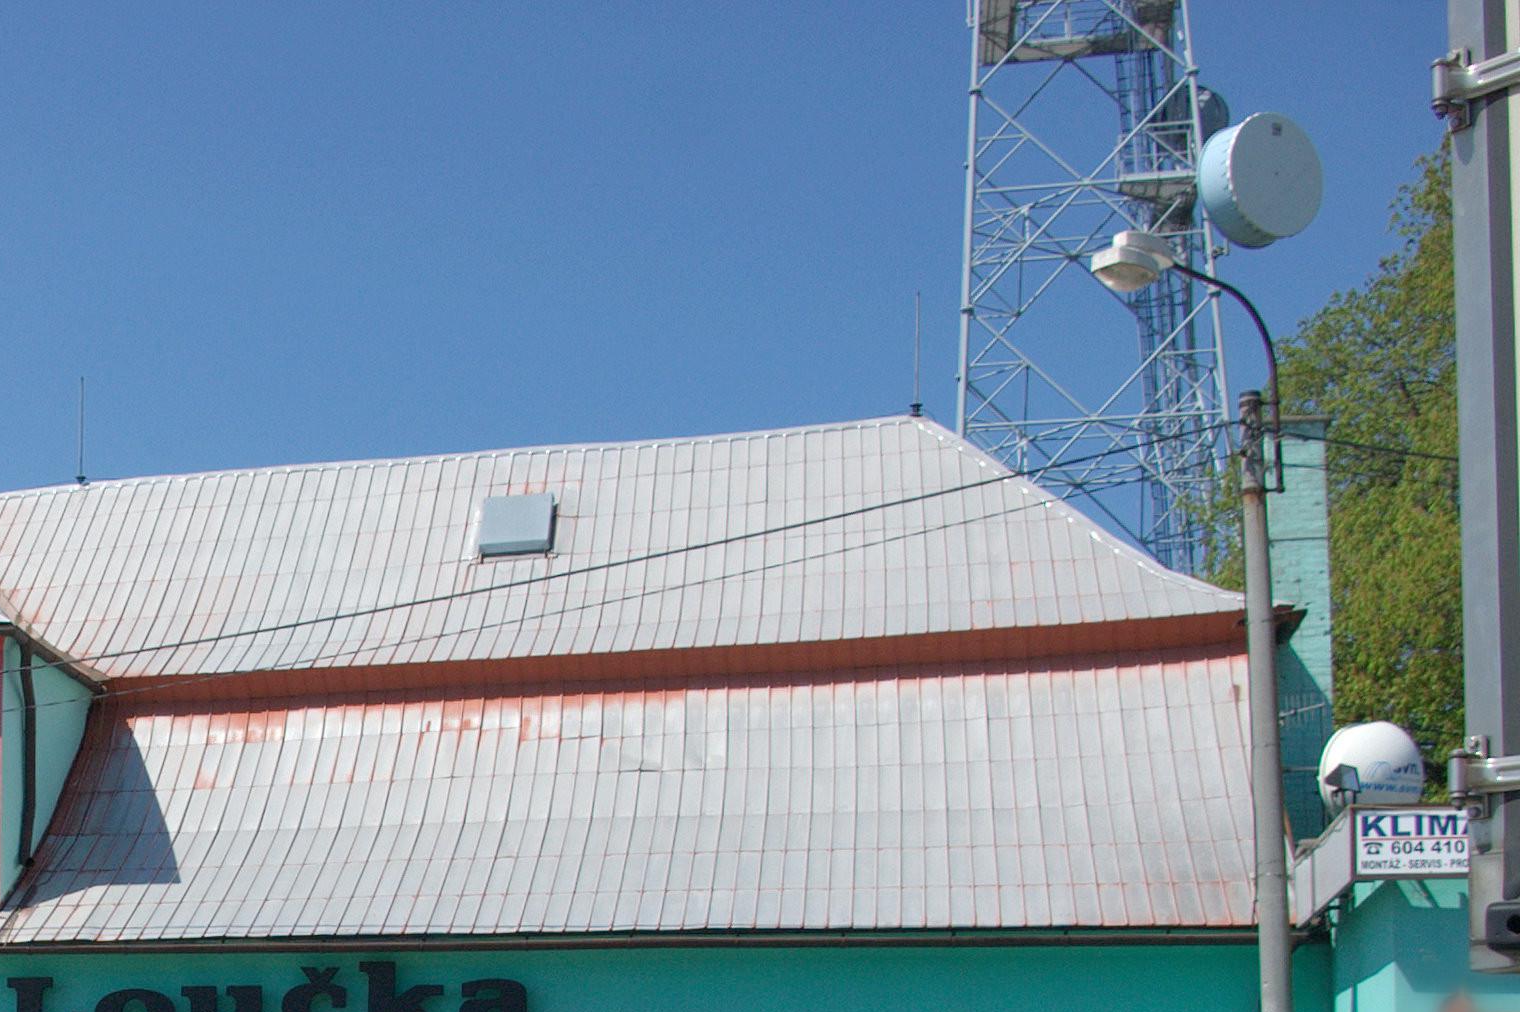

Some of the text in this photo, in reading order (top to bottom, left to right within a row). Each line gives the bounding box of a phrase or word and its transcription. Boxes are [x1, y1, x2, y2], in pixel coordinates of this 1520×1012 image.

[1362, 814, 1468, 837] KLIM
[1391, 840, 1465, 854] 604 410
[1408, 858, 1442, 869] SERVIS
